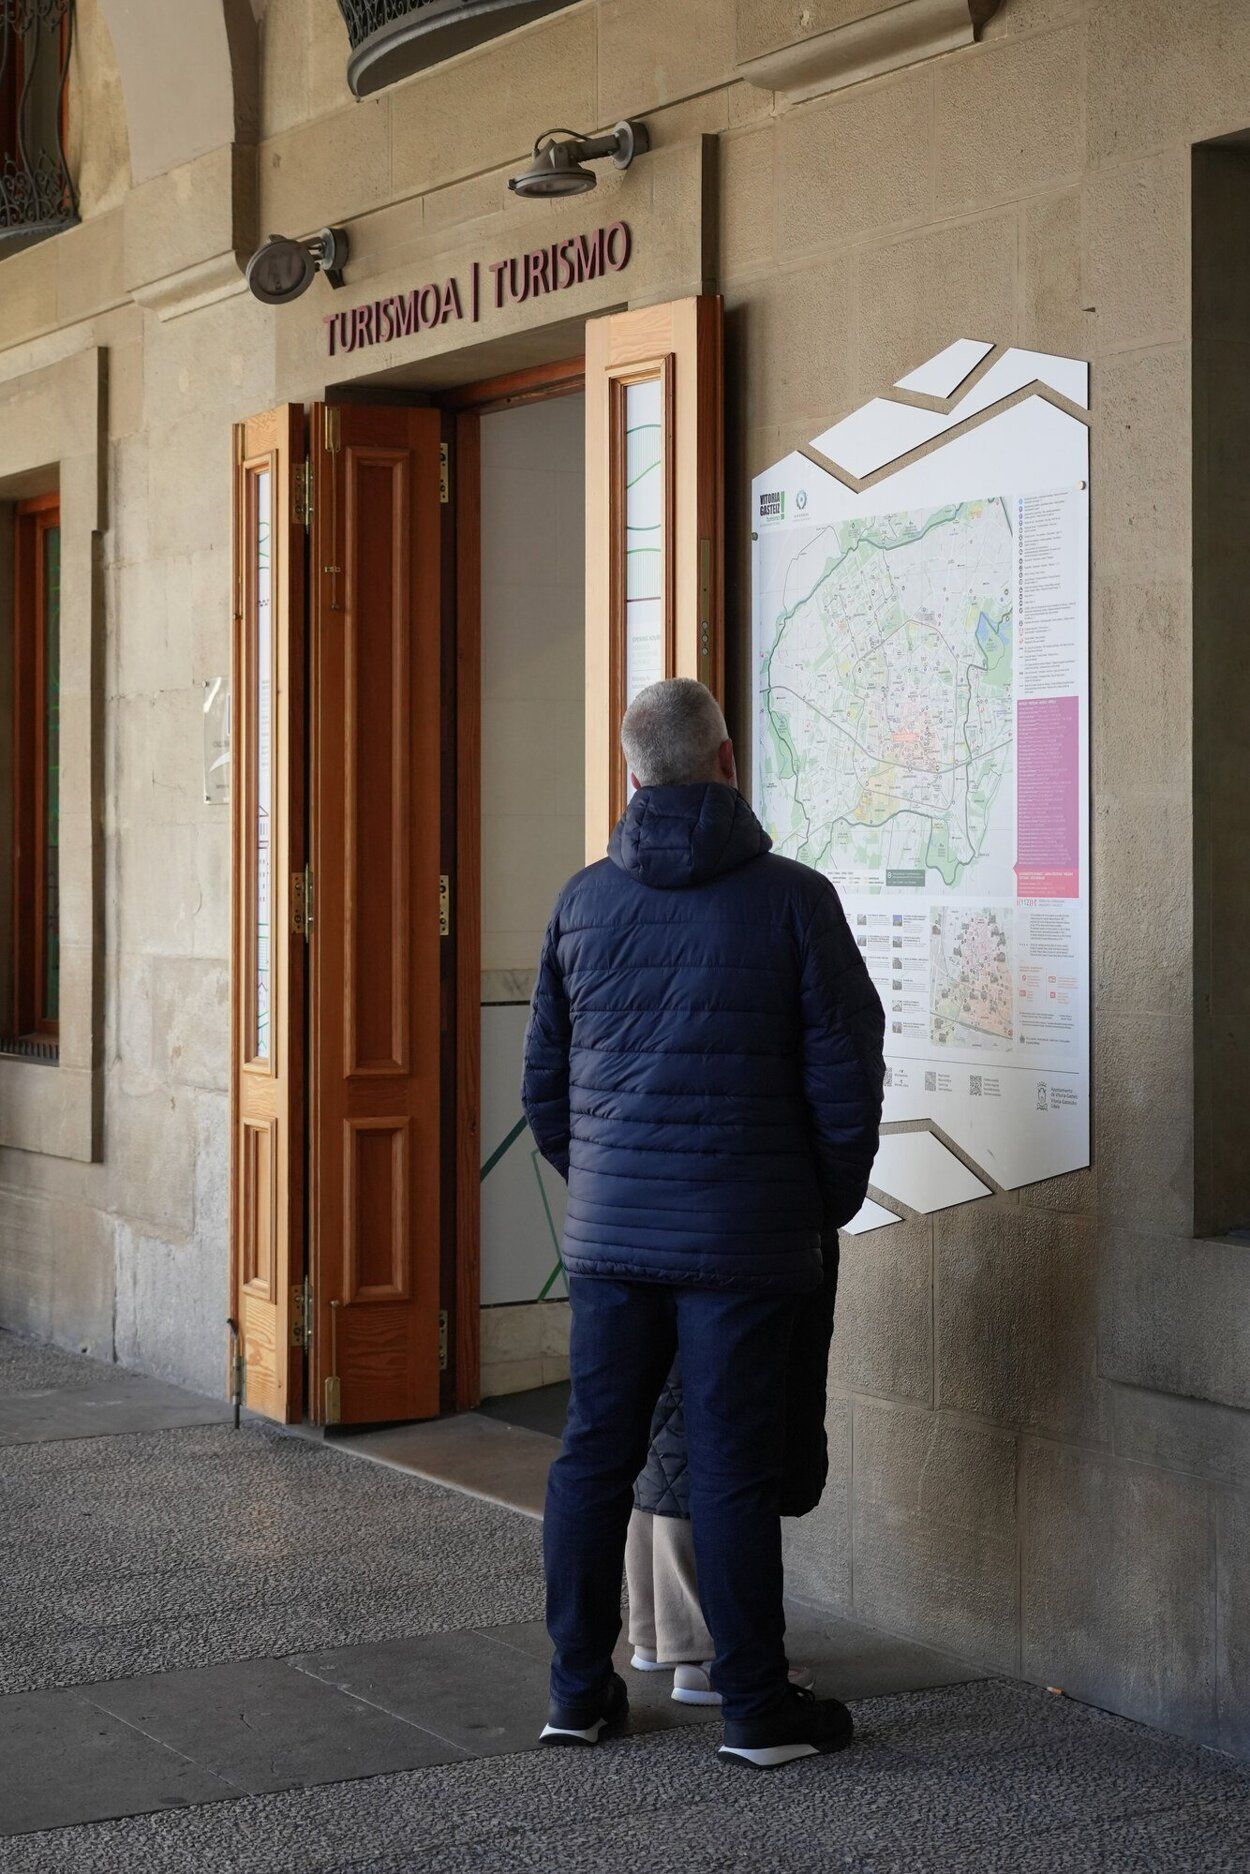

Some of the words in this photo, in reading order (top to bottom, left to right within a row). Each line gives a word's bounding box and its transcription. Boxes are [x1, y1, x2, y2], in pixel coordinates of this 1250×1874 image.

[323, 278, 463, 356] TURISMOA
[489, 220, 632, 308] TURISMO
[760, 503, 780, 516] GASTEIZ
